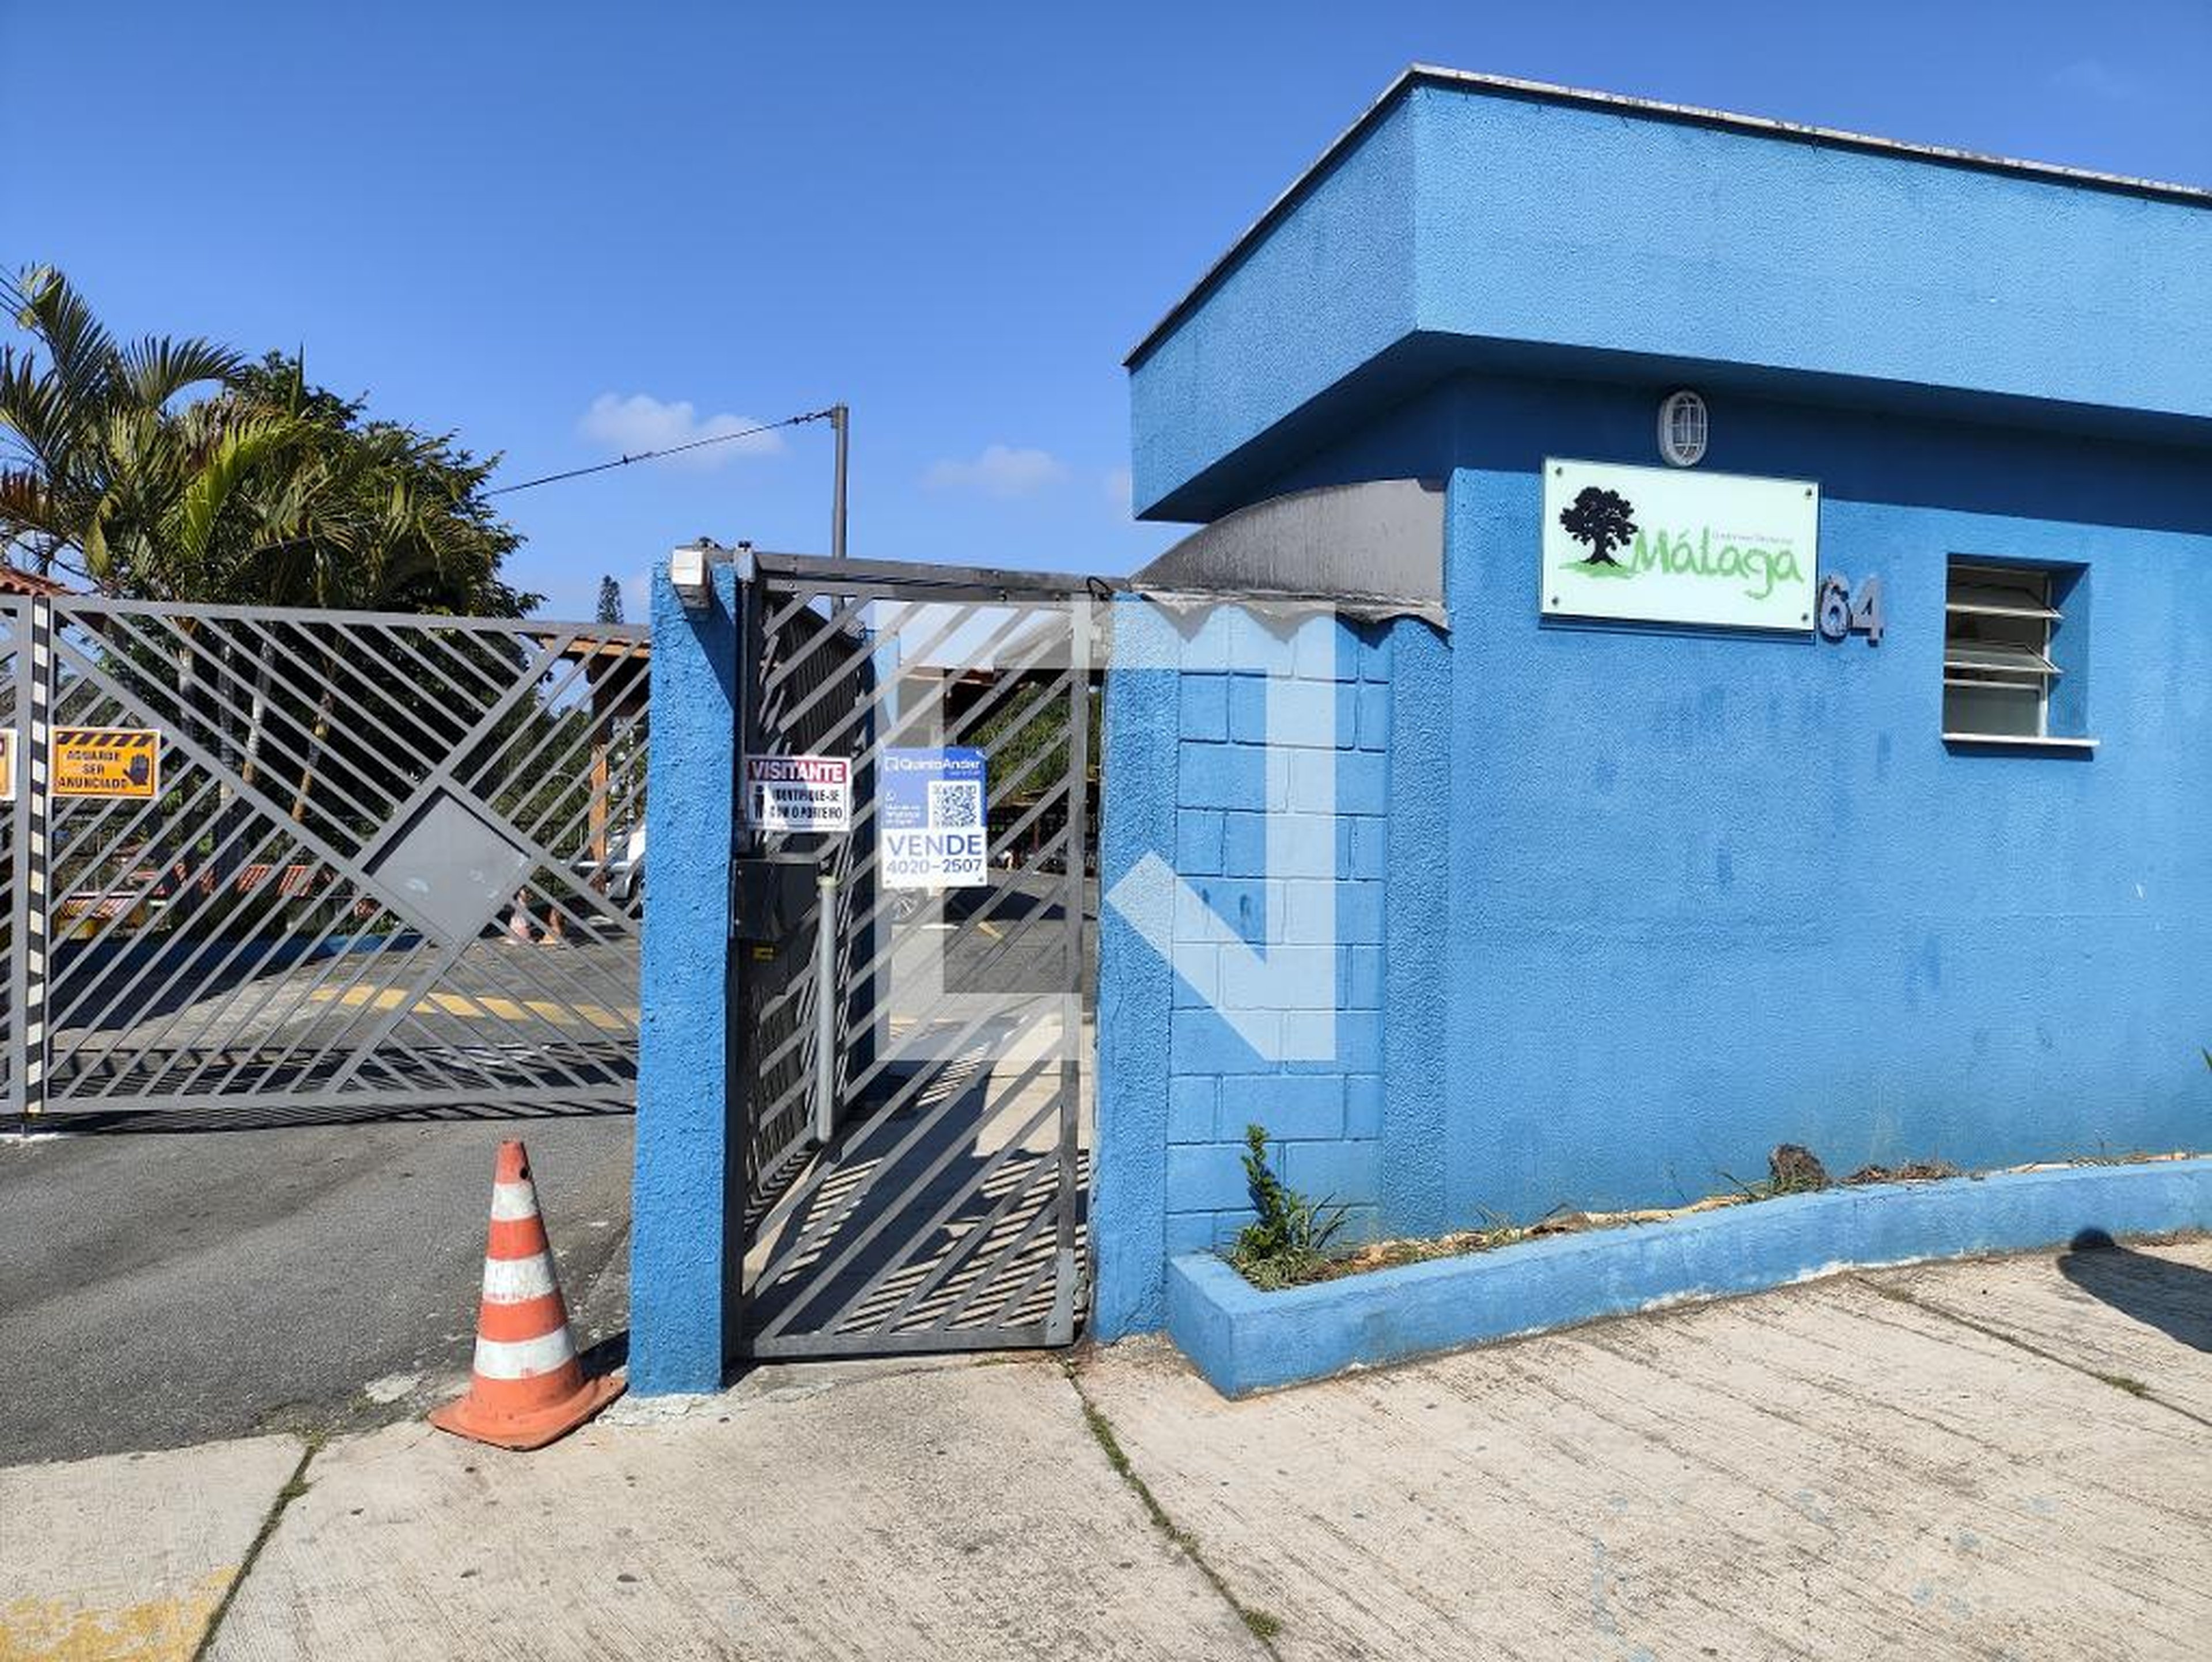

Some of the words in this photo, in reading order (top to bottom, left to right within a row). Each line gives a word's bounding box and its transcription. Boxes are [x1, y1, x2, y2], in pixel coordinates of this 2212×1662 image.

[1629, 526, 1804, 600] Málaga
[1819, 574, 1884, 647] 64
[82, 764, 104, 775] SER
[752, 761, 844, 782] VISITANTE
[887, 834, 982, 856] VENDE
[886, 858, 982, 874] 4020-2507
